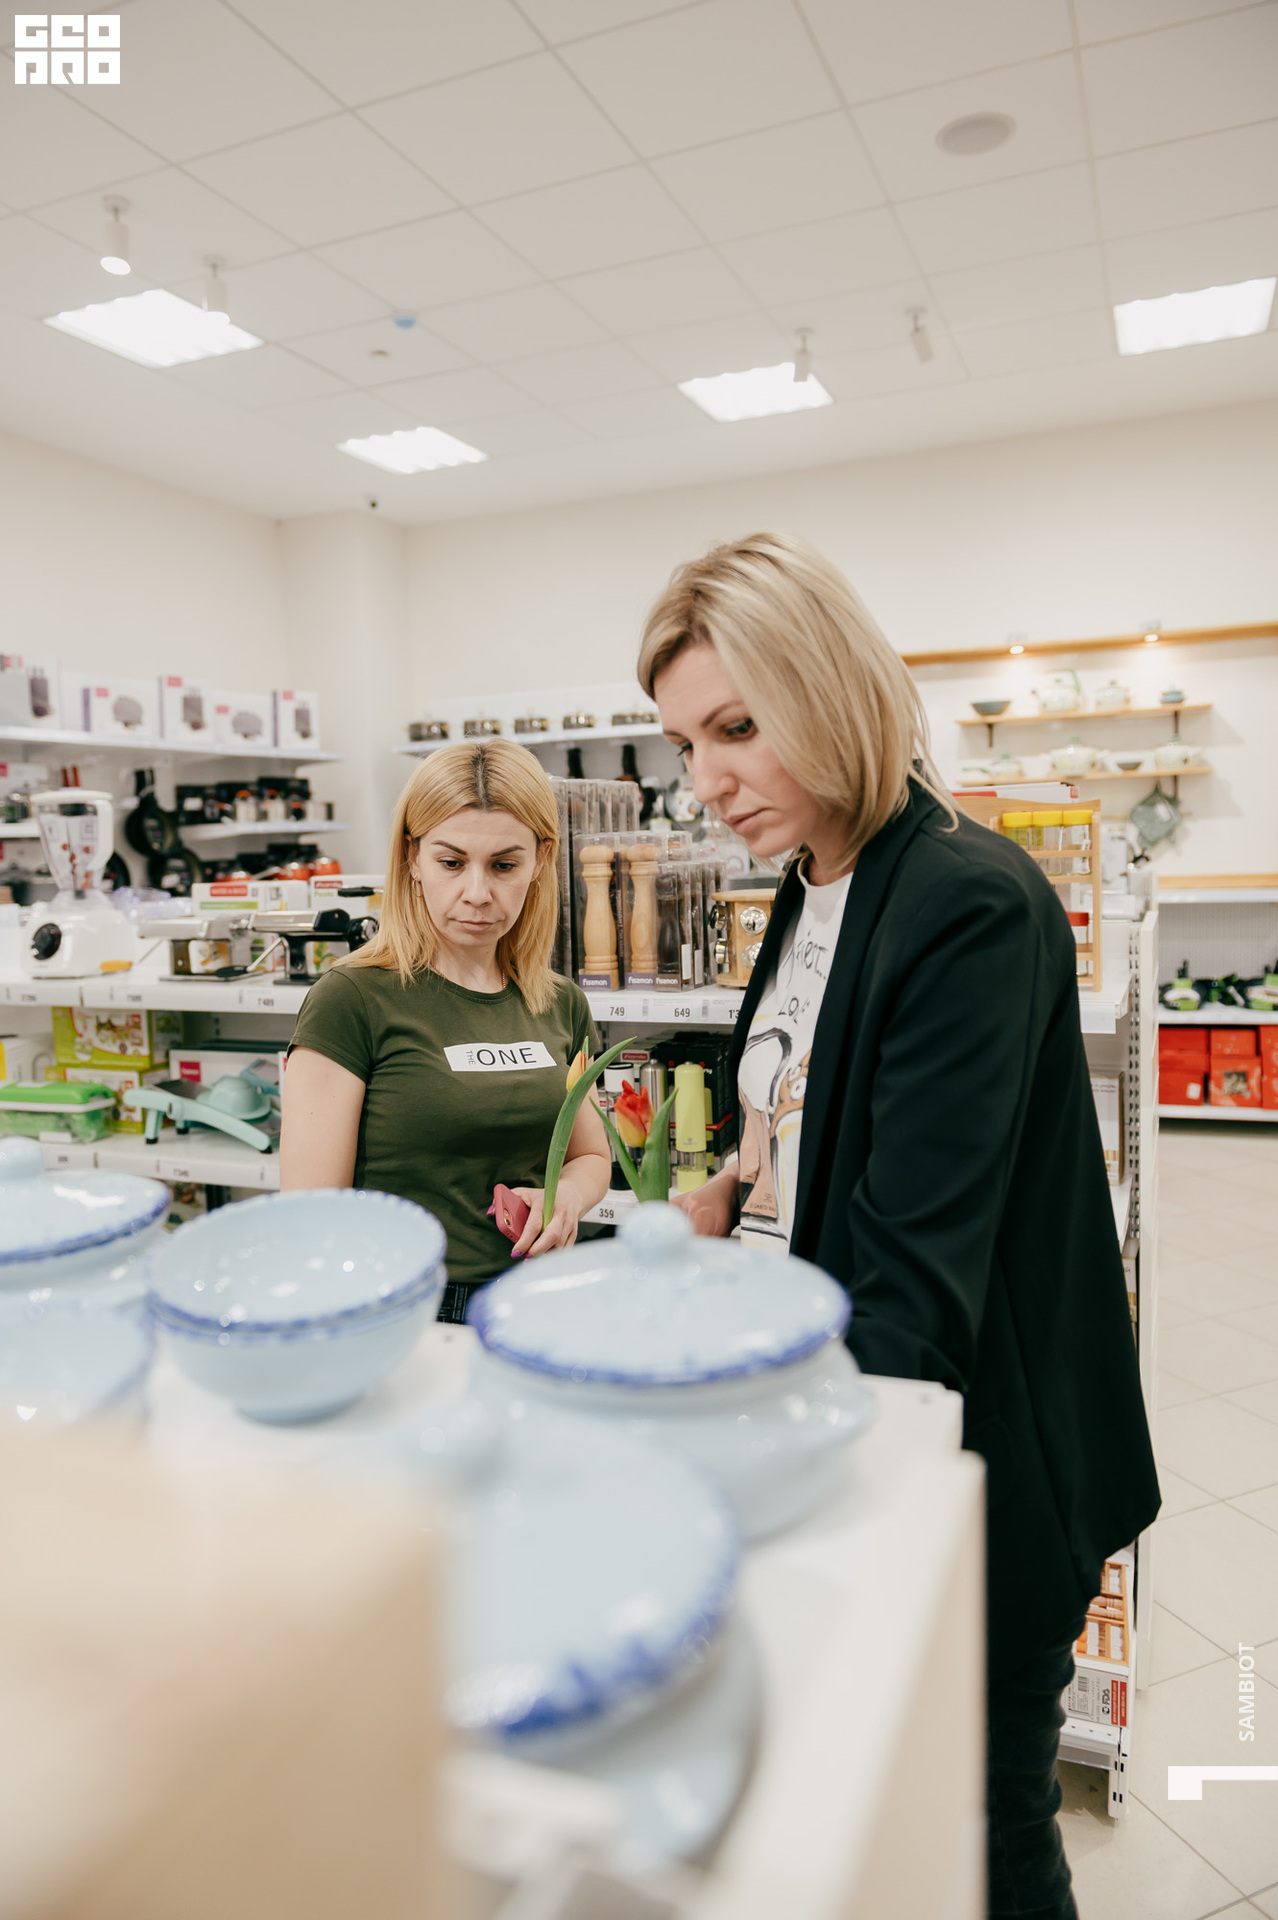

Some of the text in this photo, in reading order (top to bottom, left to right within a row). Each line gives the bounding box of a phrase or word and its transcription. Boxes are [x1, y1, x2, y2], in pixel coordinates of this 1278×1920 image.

[610, 1006, 625, 1016] 749
[674, 1007, 691, 1018] 649
[465, 1047, 537, 1066] THE ONE
[599, 1207, 615, 1218] 359
